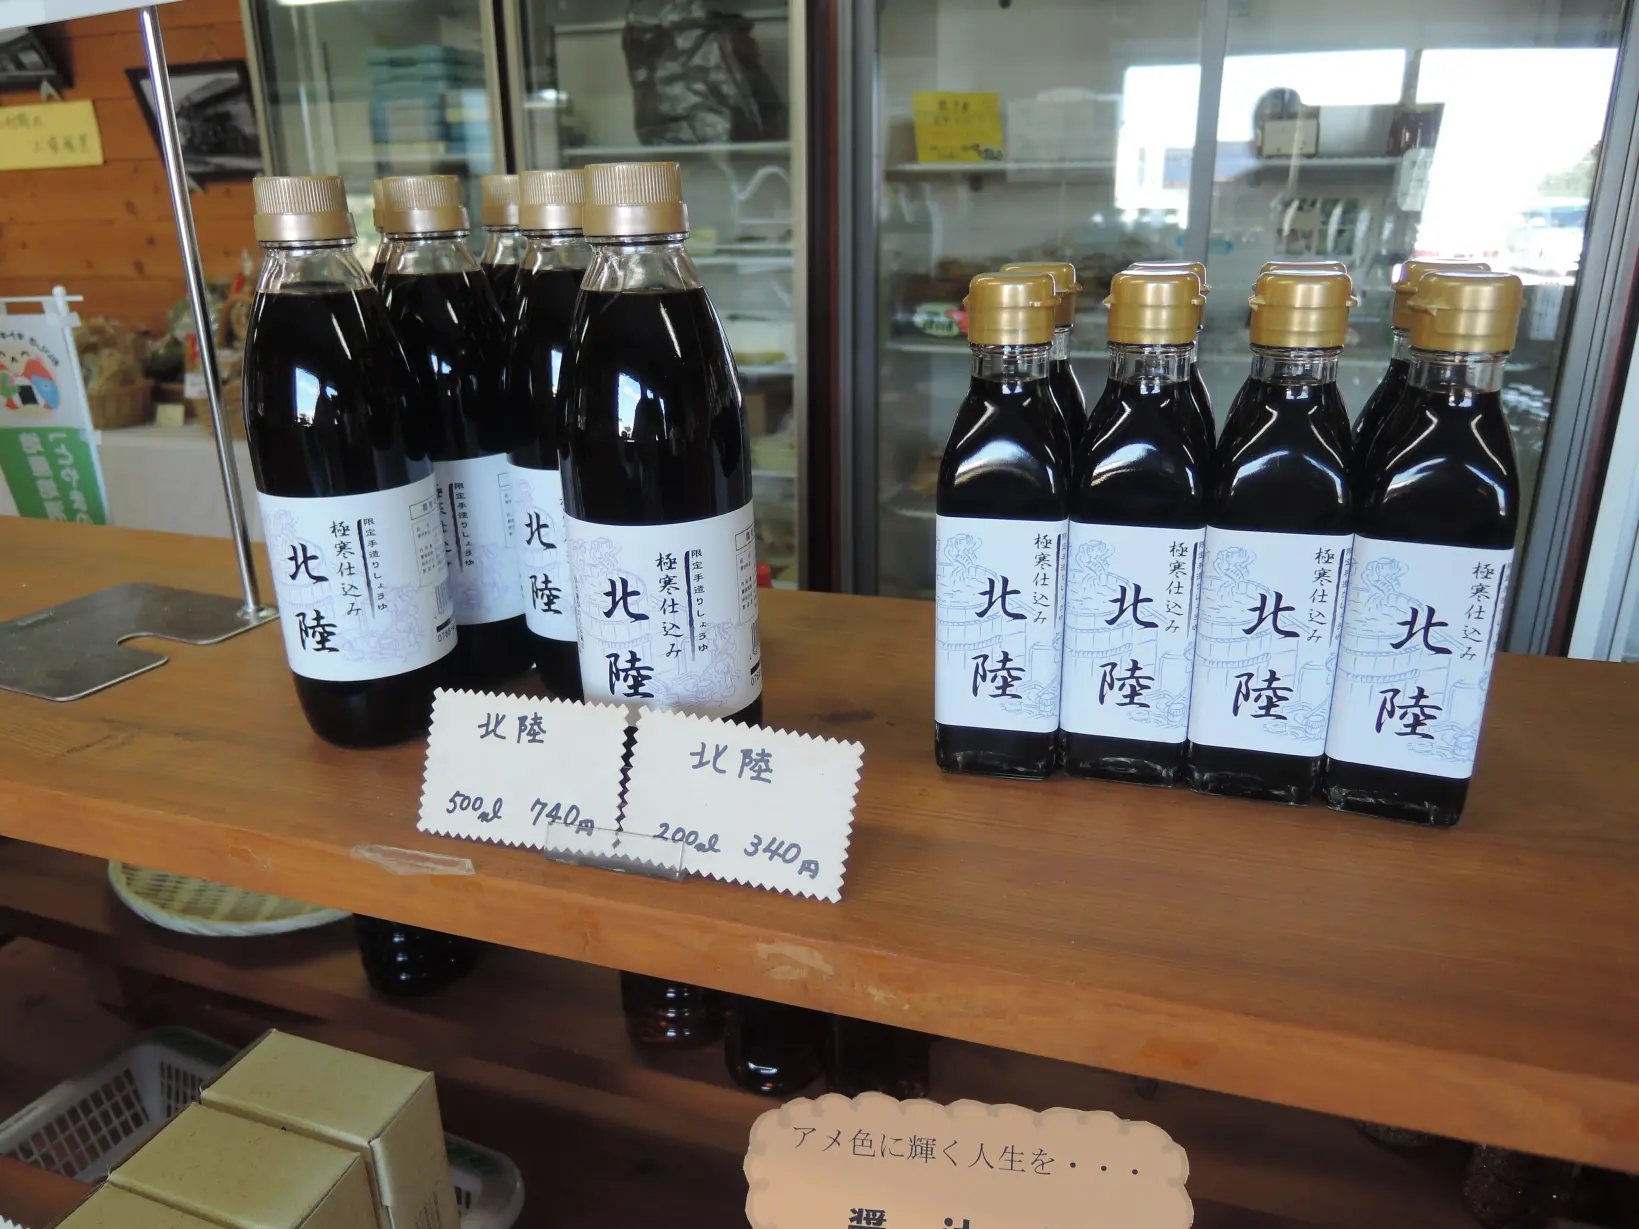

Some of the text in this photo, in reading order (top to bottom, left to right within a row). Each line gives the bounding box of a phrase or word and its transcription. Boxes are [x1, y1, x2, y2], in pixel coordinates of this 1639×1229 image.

[287, 542, 340, 653] 北陸
[329, 520, 364, 616] 極寒仕込み
[363, 517, 388, 611] 限定手造りしょうゆ
[524, 511, 563, 615] 北陸
[656, 552, 685, 659] 極寒仕込み
[691, 549, 709, 652] 限定手造りしょうゆ
[1032, 533, 1053, 625] 極寒仕込み
[1164, 540, 1189, 634] 極寒仕込み
[1307, 547, 1336, 643] 極寒仕込み
[1460, 561, 1495, 660] 極寒仕込み
[603, 577, 655, 699] 北陸
[971, 574, 1028, 700] 北陸
[1098, 582, 1160, 709] 北陸
[1232, 590, 1301, 721] 北陸
[1375, 604, 1454, 740] 北陸
[477, 711, 547, 744] 北陸
[689, 741, 773, 784] 北陸
[530, 798, 595, 836] 740円
[743, 834, 820, 880] 340円
